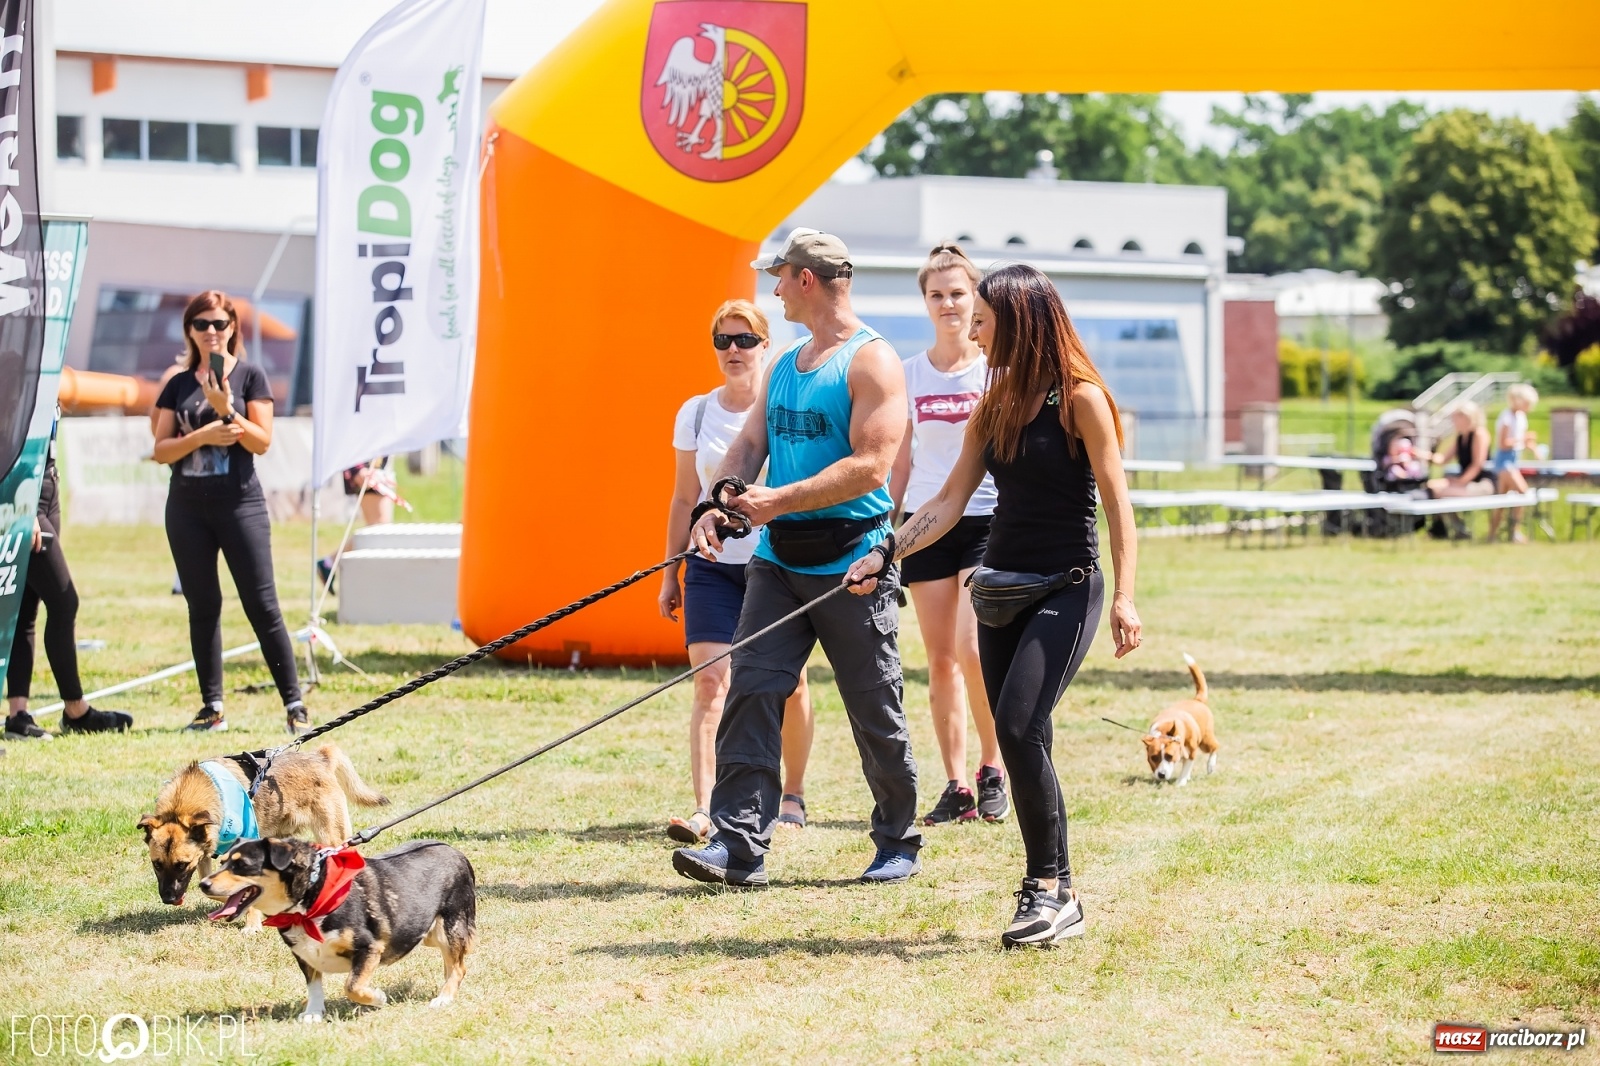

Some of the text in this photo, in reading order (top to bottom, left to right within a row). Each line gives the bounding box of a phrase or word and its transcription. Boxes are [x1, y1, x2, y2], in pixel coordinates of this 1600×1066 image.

[436, 155, 460, 188] dogs
[355, 89, 424, 414] TropiDog
[438, 257, 456, 279] all
[439, 282, 459, 302] for
[438, 305, 461, 341] foods
